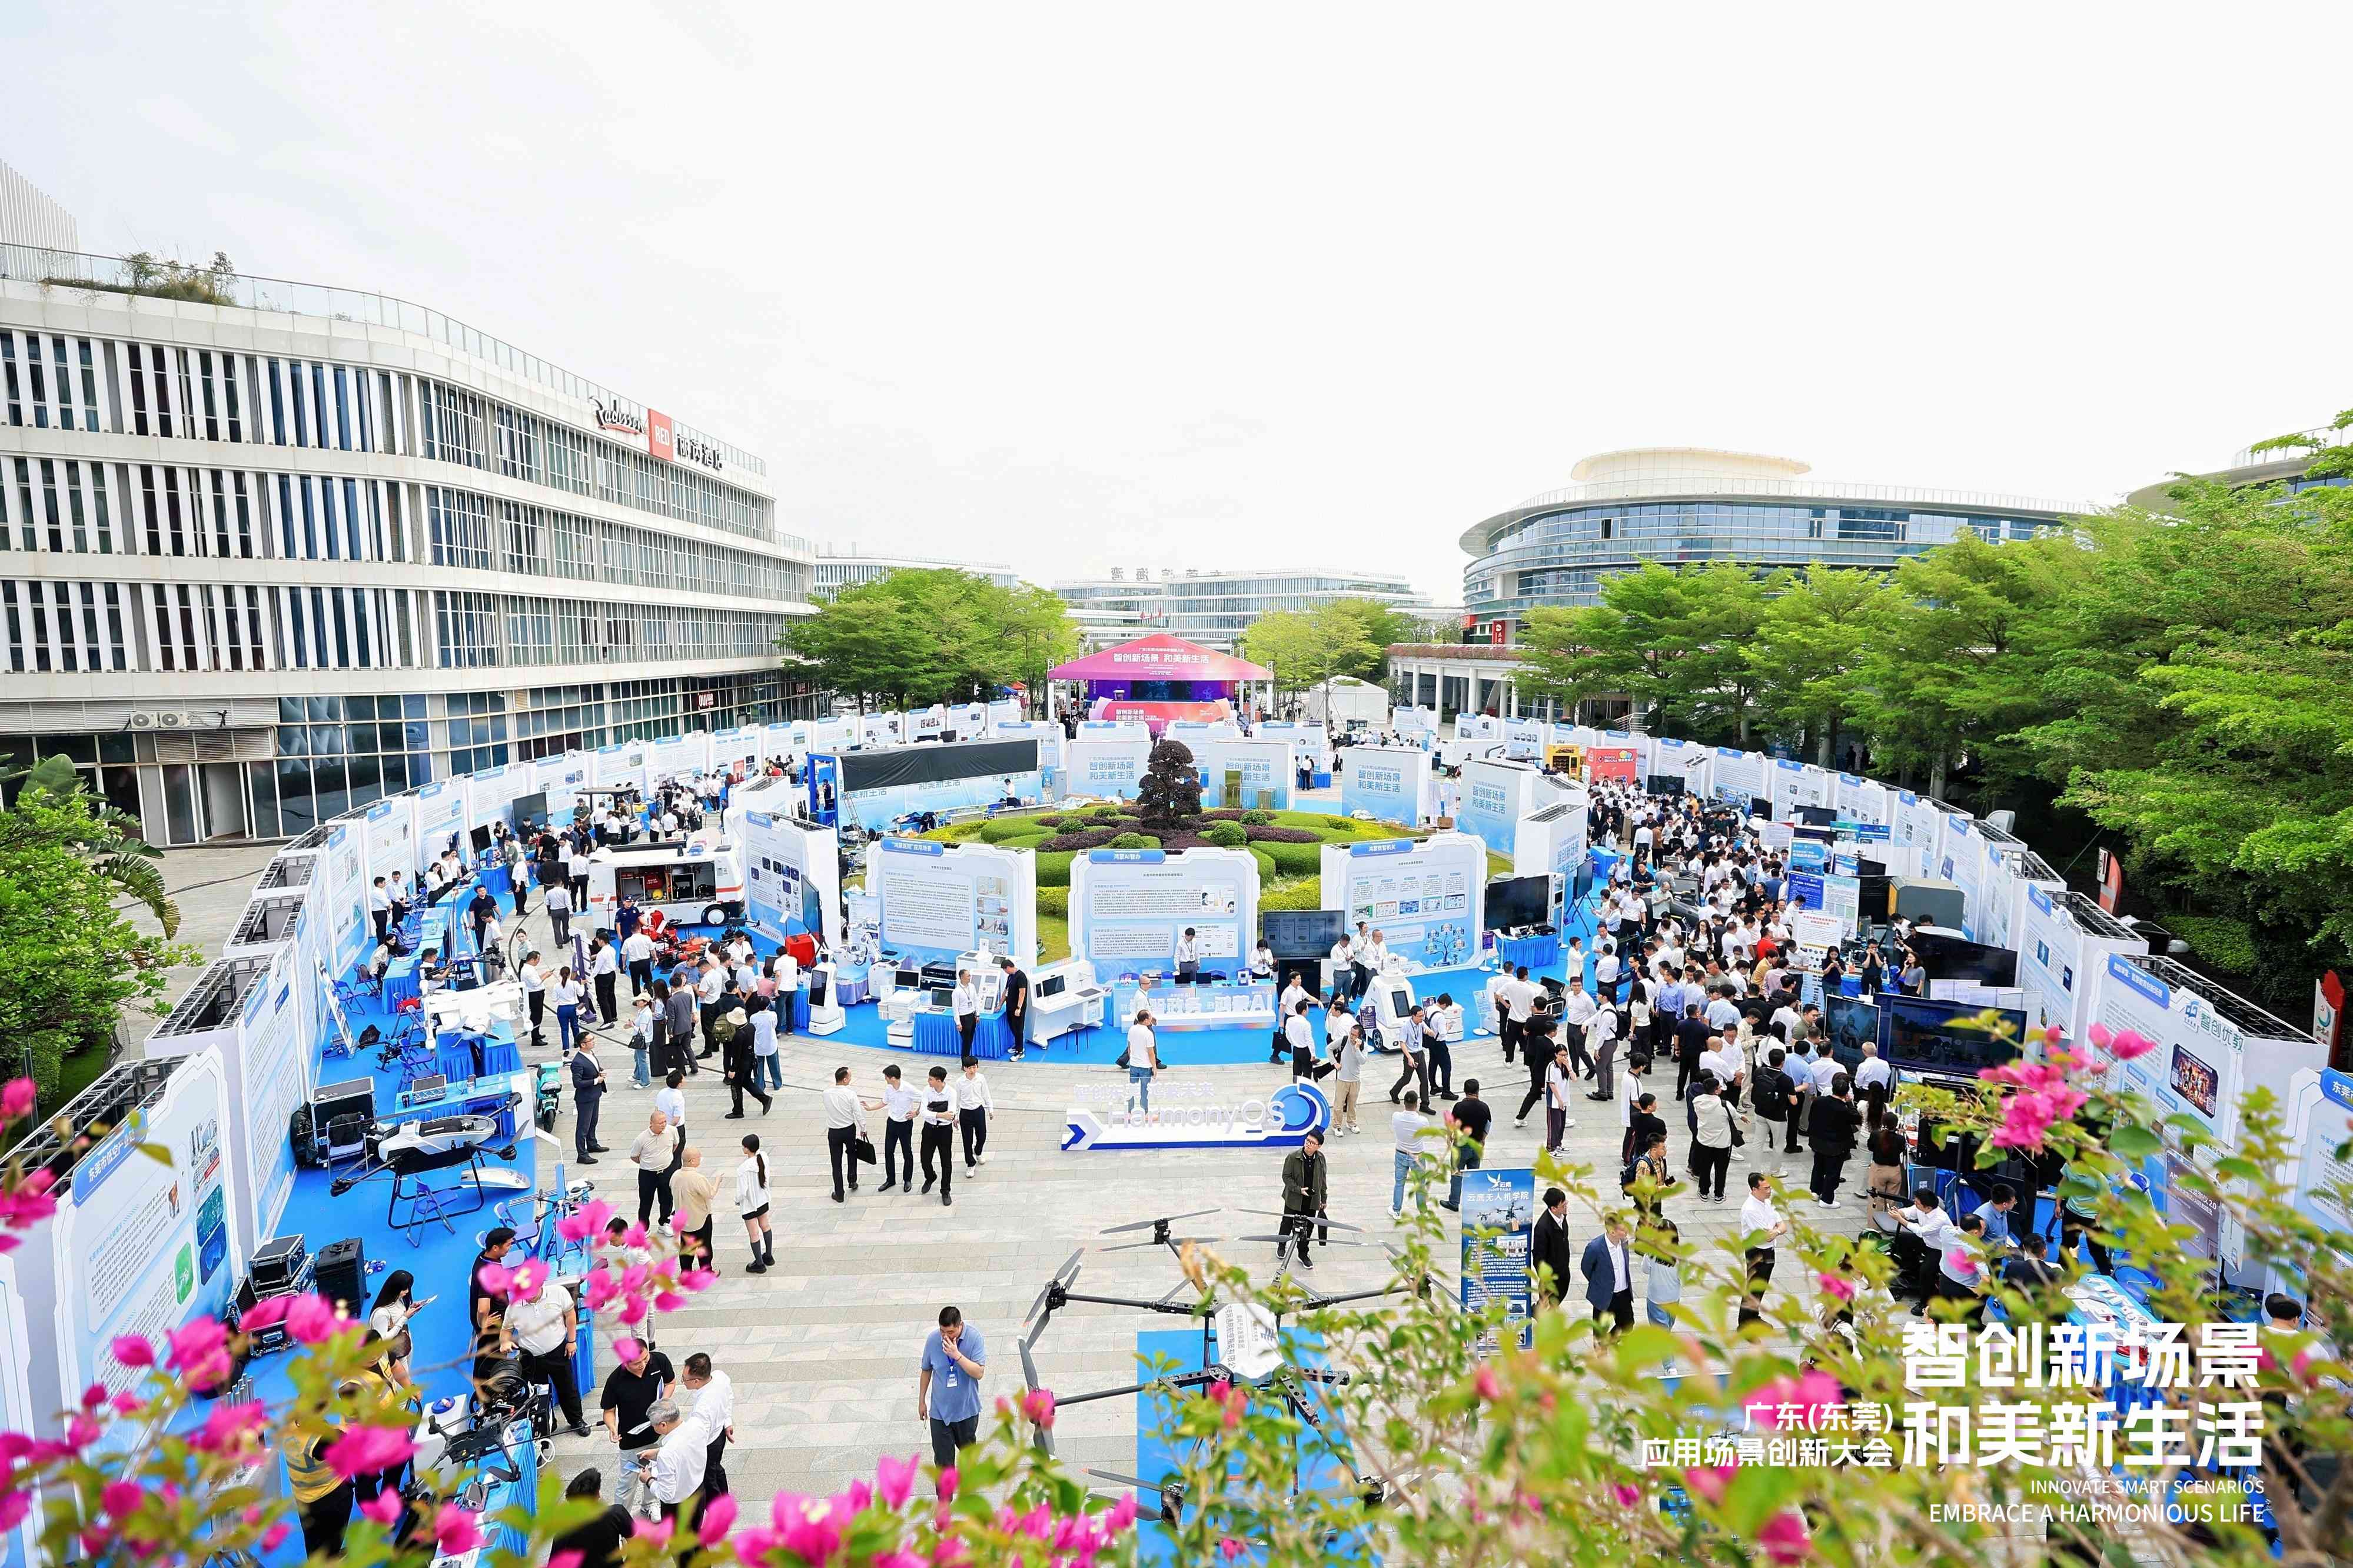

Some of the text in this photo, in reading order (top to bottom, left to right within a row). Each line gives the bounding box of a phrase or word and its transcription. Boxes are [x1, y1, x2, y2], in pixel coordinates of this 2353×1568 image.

[589, 395, 647, 434] Radisson
[654, 424, 670, 446] RED
[1114, 653, 1210, 664] 智创新场景 和美新生活
[1089, 761, 1135, 771] 智创新场景
[1225, 762, 1271, 772] 智创新场景
[1089, 771, 1135, 780] 和美新生活
[1358, 770, 1401, 783] 智创新场景
[1358, 780, 1401, 793] 和美新生活
[1472, 785, 1506, 803] 智创新场景
[1472, 797, 1506, 814] 和美新生活
[2201, 1011, 2245, 1052] 智创优教
